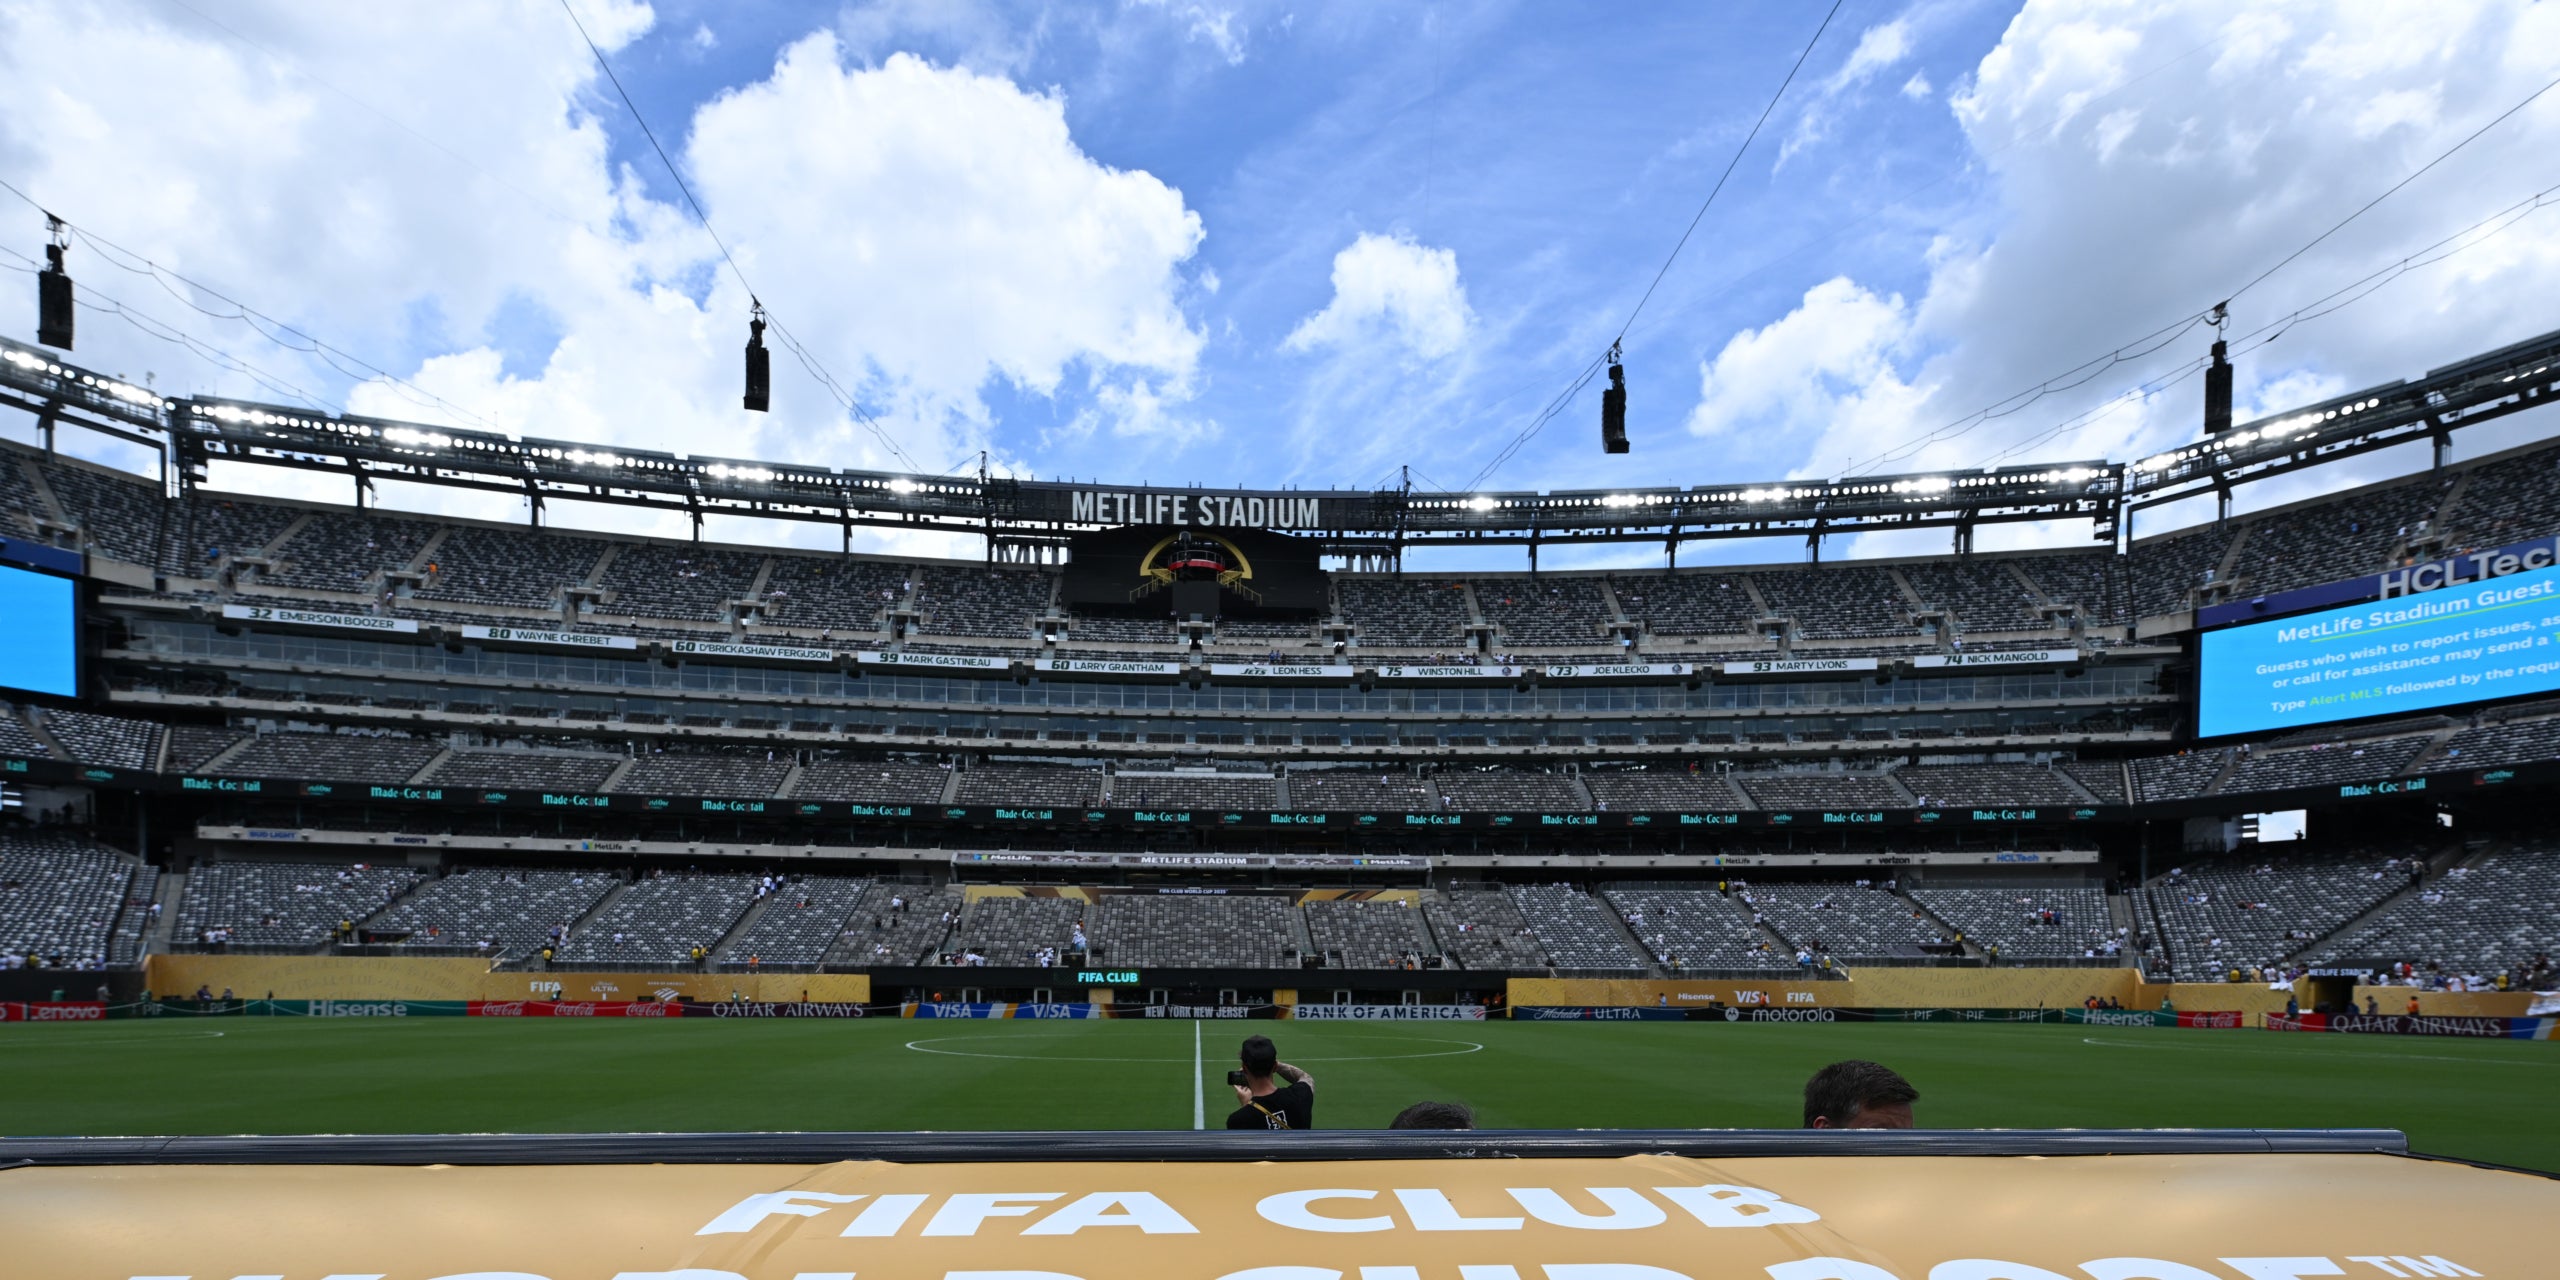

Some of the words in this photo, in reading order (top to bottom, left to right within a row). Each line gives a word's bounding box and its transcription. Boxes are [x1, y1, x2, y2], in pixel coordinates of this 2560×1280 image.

[1072, 491, 1188, 526] METLIFE
[1199, 495, 1320, 529] STADIUM
[2381, 535, 2560, 600] HCLTec
[2277, 616, 2363, 643] MetLife
[2369, 598, 2470, 627] Stadium
[2477, 580, 2555, 606] Guest
[248, 608, 273, 619] 32
[279, 611, 342, 625] EMERSON
[344, 617, 394, 629] BOOZER
[488, 628, 511, 639] 80
[515, 631, 558, 642] WAYNE
[560, 634, 611, 646] CHREBET
[675, 641, 696, 652] 60
[778, 648, 831, 660] FERGUSON
[2256, 659, 2309, 675] Guests
[2312, 653, 2346, 666] who
[2350, 645, 2387, 660] wish
[2391, 643, 2410, 653] to
[2413, 631, 2470, 648] report
[2474, 621, 2537, 640] issues,
[879, 652, 899, 663] 99
[903, 655, 934, 665] MARK
[935, 656, 991, 667] GASTINEAU
[1944, 655, 1963, 665] 74
[1967, 653, 1992, 663] NICK
[1993, 651, 2049, 663] MANGOLD
[2272, 678, 2290, 688] or
[2293, 672, 2321, 685] call
[2324, 669, 2349, 681] for
[2352, 654, 2441, 676] assistance
[2445, 647, 2483, 661] may
[2488, 637, 2533, 654] send
[2537, 636, 2549, 646] a
[1051, 660, 1070, 670] 60
[1074, 661, 1106, 671] LARRY
[1108, 662, 1165, 672] GRANTHAM
[1272, 666, 1298, 675] LEON
[1299, 666, 1322, 675] HESS
[1386, 666, 1402, 676] 75
[1417, 667, 1462, 676] WINSTON
[1464, 666, 1484, 675] HILL
[1556, 666, 1573, 676] 73
[1593, 666, 1611, 675] JOE
[1612, 665, 1650, 675] KLECKO
[1753, 661, 1771, 672] 93
[1776, 661, 1813, 671] MARTY
[1814, 660, 1848, 670] LYONS
[2271, 700, 2306, 713] Type
[2309, 693, 2346, 706] Alert
[2350, 687, 2383, 700] MLS
[2386, 676, 2457, 695] followed
[2461, 673, 2482, 685] by
[2485, 668, 2514, 680] the
[594, 842, 623, 851] MetLife
[1141, 856, 1192, 864] METLIFE
[1195, 857, 1247, 865] STADIUM
[1878, 855, 1911, 865] verizon
[1996, 854, 2039, 863] HCLTech
[1077, 972, 1104, 983] FIFA
[1106, 972, 1138, 983] CLUB
[530, 981, 562, 992] FIFA
[1678, 992, 1715, 1001] Hisense
[1786, 992, 1815, 1003] FIFA
[308, 1001, 408, 1017] Hisense
[713, 1002, 776, 1018] QATAR
[784, 1002, 864, 1018] AIRWAYS
[933, 1004, 972, 1018] VISA
[1032, 1004, 1071, 1018] VISA
[1145, 1006, 1166, 1018] NEW
[1168, 1006, 1192, 1018] YORK
[1193, 1006, 1214, 1018] NEW
[1216, 1006, 1249, 1018] JERSEY
[1299, 1006, 1347, 1019] BANK
[1353, 1006, 1376, 1019] OF
[1380, 1006, 1462, 1019] AMERICA
[1595, 1007, 1641, 1019] ULTRA
[1752, 1007, 1835, 1022] motorola
[1914, 1010, 1933, 1020] PIF
[1966, 1010, 1985, 1020] PIF
[2018, 1010, 2038, 1020] PIF
[2083, 1009, 2155, 1027] Hisense
[2333, 1014, 2400, 1033] QATAR
[2407, 1016, 2501, 1037] AIRWAYS
[694, 1189, 1201, 1238] FIFA
[1255, 1184, 1822, 1234] CLUB
